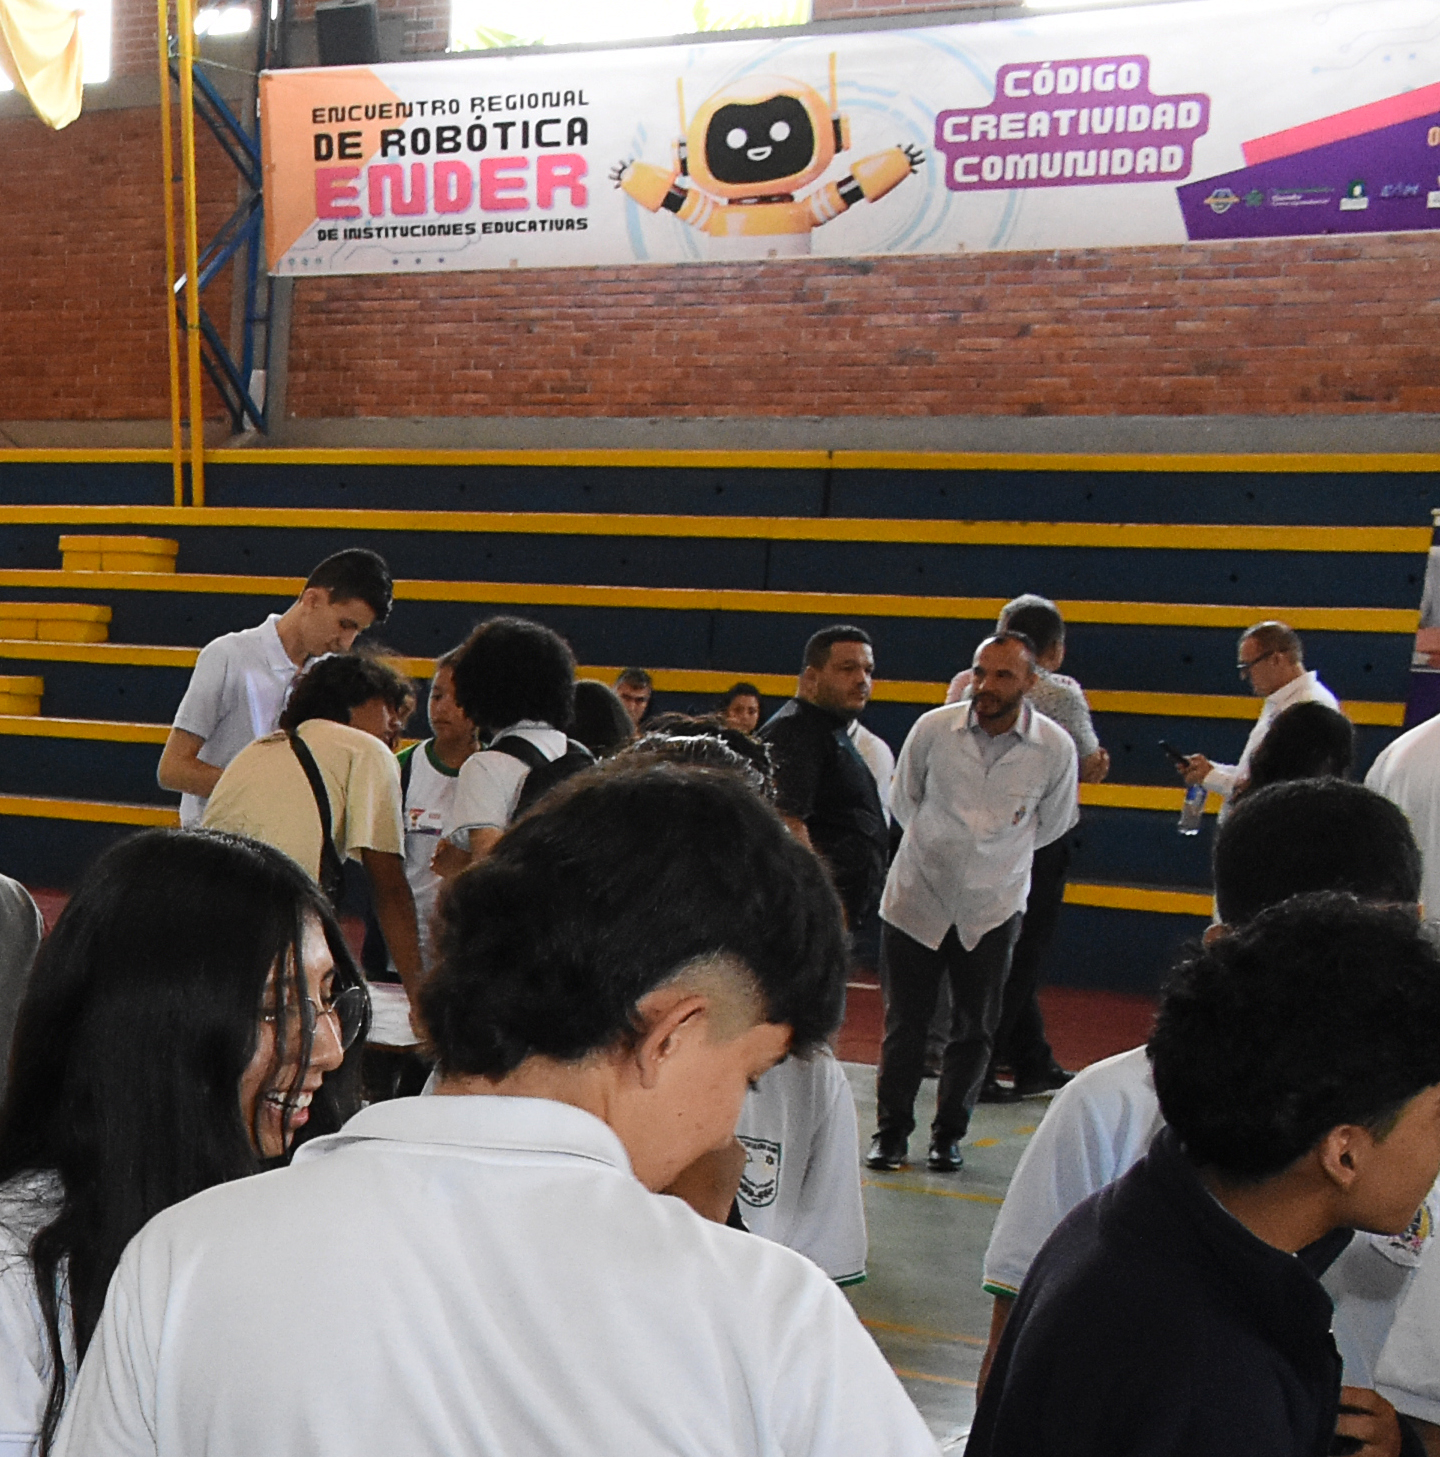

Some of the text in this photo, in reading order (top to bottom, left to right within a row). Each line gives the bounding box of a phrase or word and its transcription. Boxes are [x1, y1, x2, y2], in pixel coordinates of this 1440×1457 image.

[1004, 62, 1142, 98] CÓDIGO
[312, 89, 590, 124] ENCUENTRO REGIONAL
[942, 101, 1202, 143] CREATIVIDAD
[314, 115, 589, 161] DE ROBÓTICA
[953, 145, 1184, 183] COMUNIDAD
[315, 153, 590, 219] ENDER
[317, 217, 589, 242] DE INSTITUCIONES EDUCATIVAS
